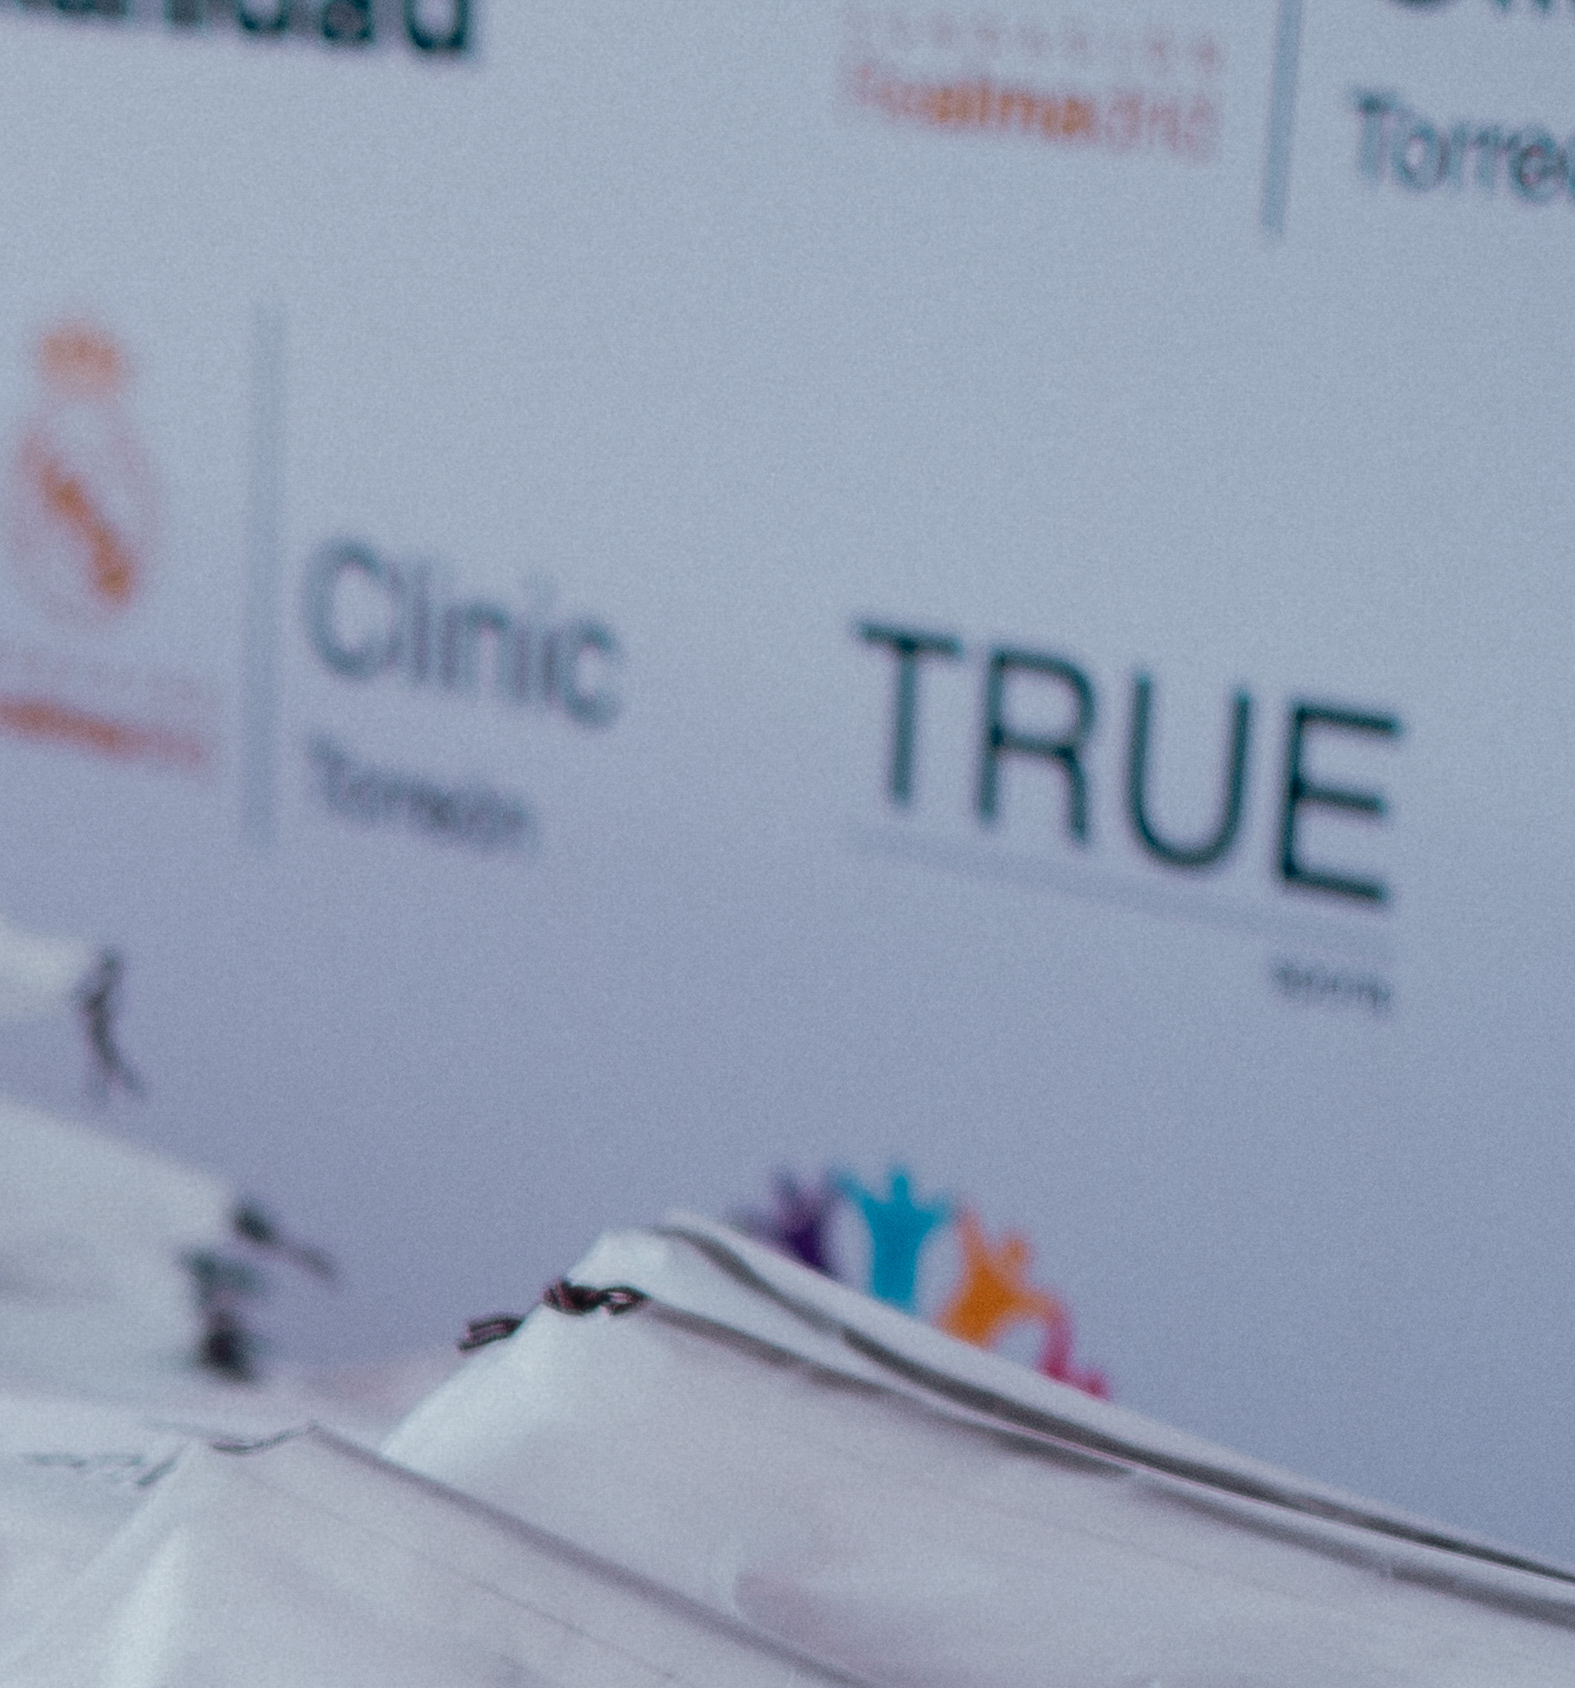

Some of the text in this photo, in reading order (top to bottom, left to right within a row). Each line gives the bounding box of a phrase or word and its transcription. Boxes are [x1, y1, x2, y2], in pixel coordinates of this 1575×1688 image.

[1351, 88, 1575, 202] Torre
[303, 540, 621, 730] Clinic
[857, 622, 1403, 908] TRUE
